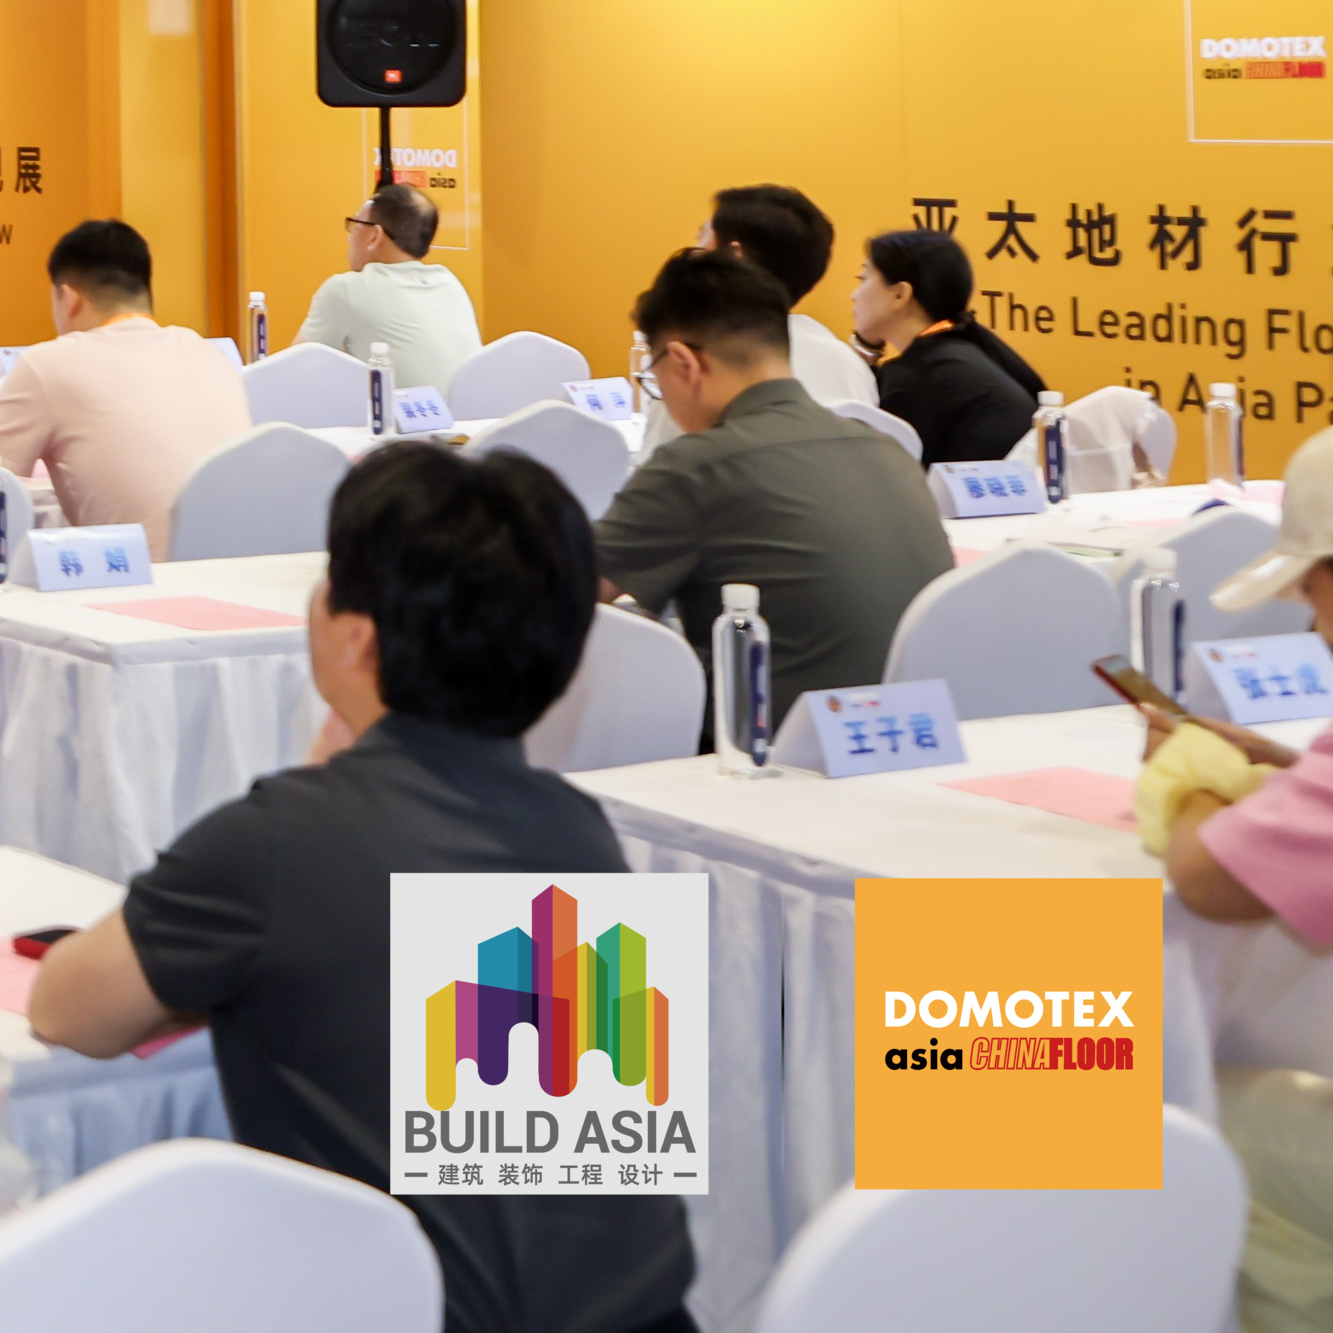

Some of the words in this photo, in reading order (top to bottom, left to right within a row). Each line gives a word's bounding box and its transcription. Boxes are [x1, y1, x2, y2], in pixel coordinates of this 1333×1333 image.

[1200, 36, 1326, 58] DOMOTEX
[981, 289, 1055, 334] The
[1071, 296, 1247, 360] Leading
[1178, 372, 1275, 421] Aia
